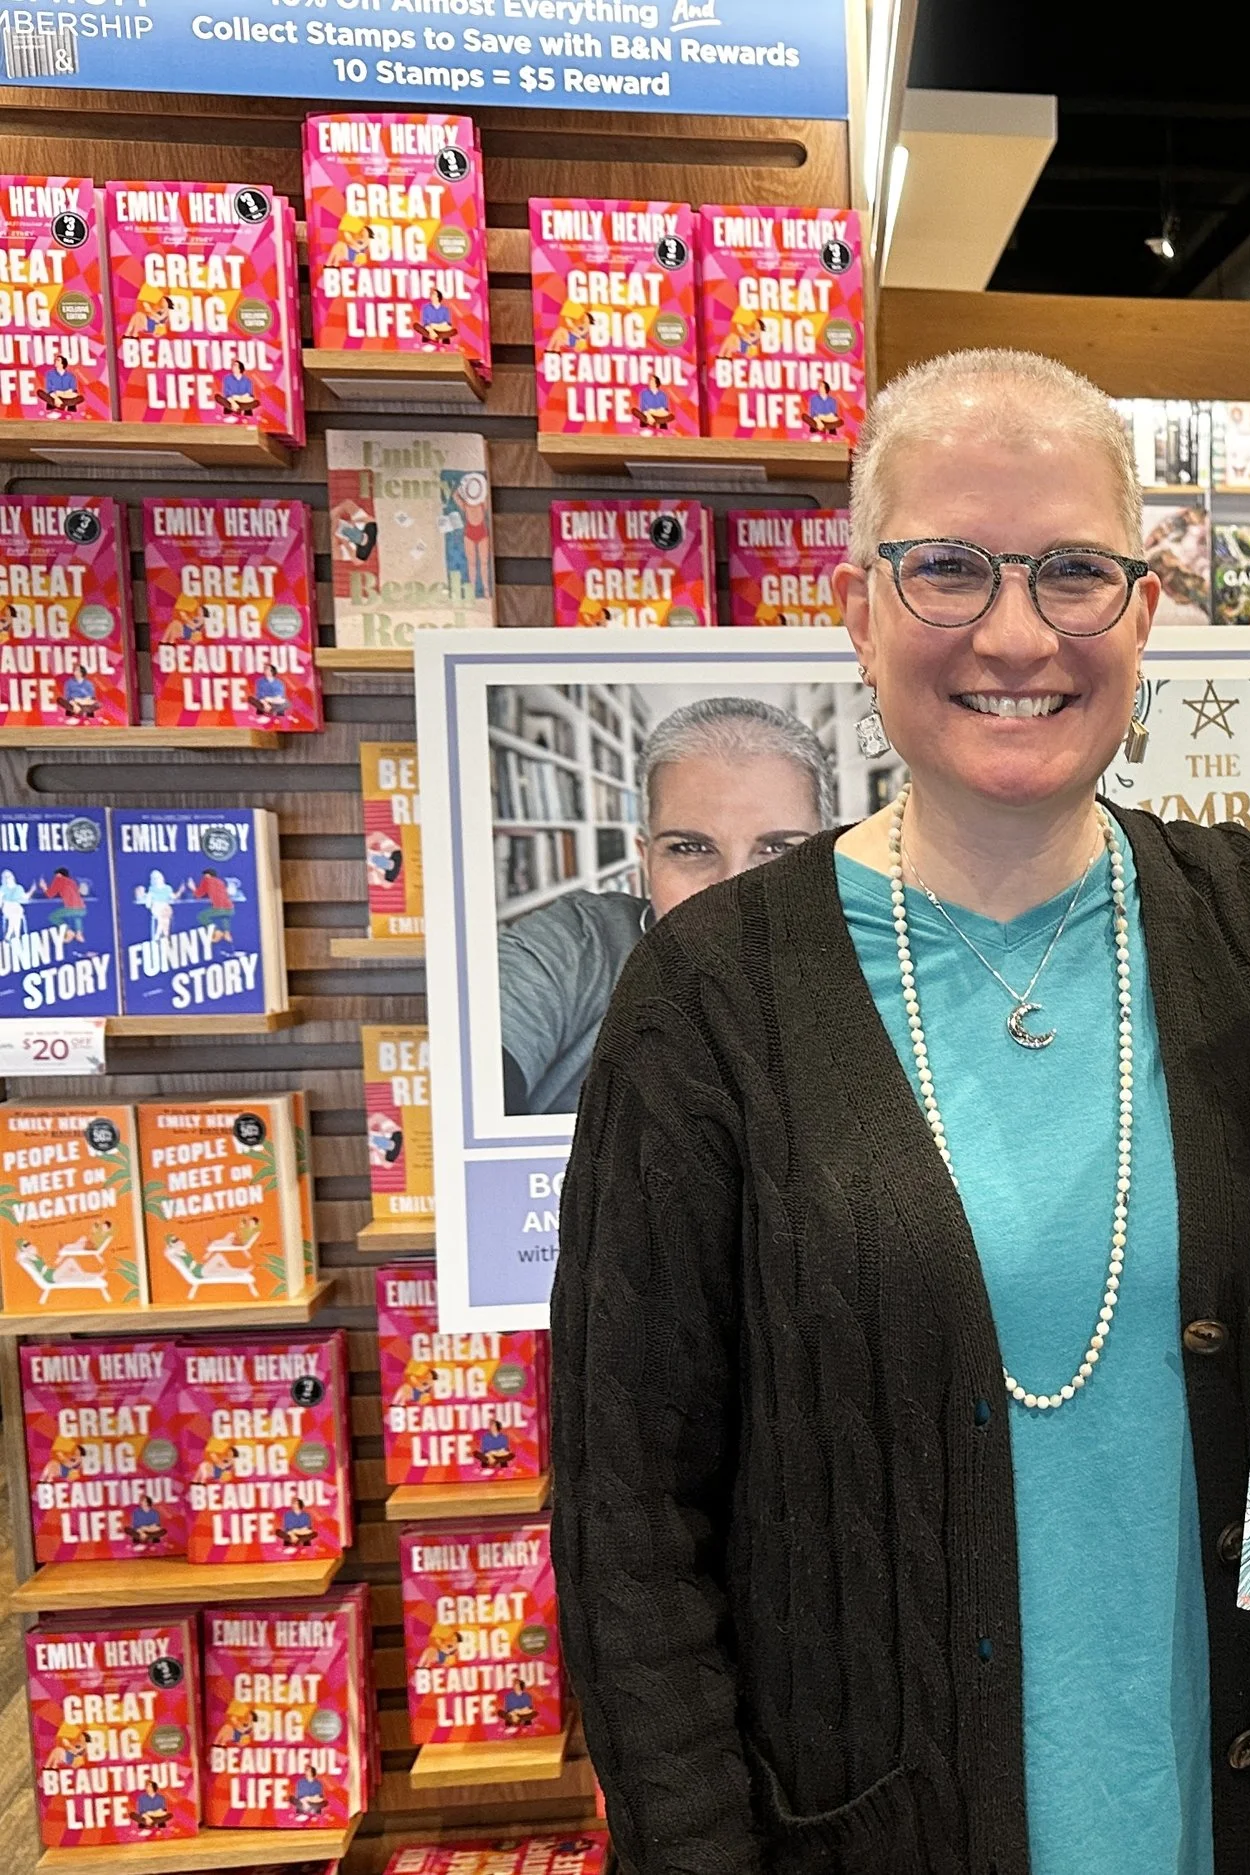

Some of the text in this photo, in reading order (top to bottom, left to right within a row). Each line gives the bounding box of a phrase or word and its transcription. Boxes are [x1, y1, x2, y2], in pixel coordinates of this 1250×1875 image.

[504, 0, 658, 28] Everything
[191, 15, 800, 67] Collect Stamps to Save with B&N Rewards
[333, 58, 368, 83] 10
[376, 60, 485, 91] Stamps
[519, 65, 556, 93] $5
[563, 68, 671, 96] Reward
[318, 122, 458, 155] EMILY HENRY
[8, 185, 80, 218] HENRY
[116, 190, 243, 225] EMILY HEN
[346, 183, 446, 220] GREAT
[541, 209, 678, 244] EMILY HENRY
[713, 216, 846, 251] EMILY HENRY
[368, 224, 428, 263] BIG
[144, 252, 246, 290] GREAT
[323, 267, 471, 301] BEAUTIFUL
[567, 270, 663, 306] GREAT
[738, 276, 832, 313] GREAT
[168, 295, 228, 334] BIG
[346, 303, 415, 338] LIFE
[589, 311, 647, 349] BIG
[760, 317, 817, 354] BIG
[123, 338, 273, 372] BEAUTIFUL
[543, 352, 688, 386] BEAUTIFUL
[147, 374, 216, 410] LIFE
[714, 359, 857, 392] BEAUTIFUL
[567, 388, 633, 423] LIFE
[738, 394, 802, 428] LIFE
[362, 439, 450, 477] Emily
[359, 471, 455, 508] Henry
[153, 506, 291, 538] EMILY HENRY
[561, 510, 617, 540] EMILY
[738, 518, 850, 548] EMILY HENR
[181, 564, 278, 598] GREAT
[351, 570, 476, 608] Beach
[586, 568, 675, 600] GREAT
[762, 575, 834, 606] GREA
[12, 603, 70, 638] BIG
[203, 603, 261, 639] BIG
[158, 644, 305, 674] BEAUTIFUL
[183, 677, 249, 711] LIFE
[1185, 754, 1241, 778] THE
[121, 824, 177, 852] EMILY
[128, 924, 216, 981] FUNNY
[23, 953, 110, 1010] STORY
[172, 952, 259, 1009] STORY
[8, 1117, 53, 1131] EMILY
[157, 1114, 201, 1128] EMILY
[3, 1141, 80, 1172] PEOPLE
[153, 1138, 228, 1168] PEOPLE
[19, 1167, 106, 1195] MEET ON
[168, 1164, 253, 1192] MEET ON
[13, 1187, 117, 1224] VACATION
[161, 1185, 263, 1220] VACATION
[386, 1279, 437, 1307] EMIL
[411, 1332, 501, 1362] GREAT
[30, 1351, 165, 1384] EMILY HENRY
[186, 1352, 320, 1384] EMILY HENRY
[433, 1366, 488, 1399] BIG
[58, 1405, 152, 1438] GREAT
[211, 1406, 306, 1439] GREAT
[389, 1401, 527, 1433] BEAUTIFUL
[82, 1442, 137, 1475] BIG
[234, 1443, 289, 1477] BIG
[411, 1434, 475, 1467] LIFE
[37, 1477, 179, 1509] BEAUTIFUL
[190, 1480, 330, 1511] BEAUTIFUL
[61, 1510, 125, 1543] LIFE
[213, 1512, 277, 1545] LIFE
[411, 1540, 541, 1572] EMILY HENRY
[436, 1591, 528, 1625] GREAT
[212, 1620, 337, 1648] EMILY HENRY
[457, 1628, 511, 1661] BIG
[36, 1637, 170, 1671] EMILY HENRY
[234, 1672, 322, 1703] GREAT
[415, 1661, 550, 1694] BEAUTIFUL
[63, 1691, 157, 1726] GREAT
[437, 1694, 498, 1728] LIFE
[252, 1709, 304, 1742] BIG
[85, 1729, 142, 1761] BIG
[212, 1746, 341, 1774] BEAUTIFUL
[42, 1762, 184, 1796] BEAUTIFUL
[230, 1778, 290, 1809] LIFE
[66, 1796, 130, 1829] LIFE
